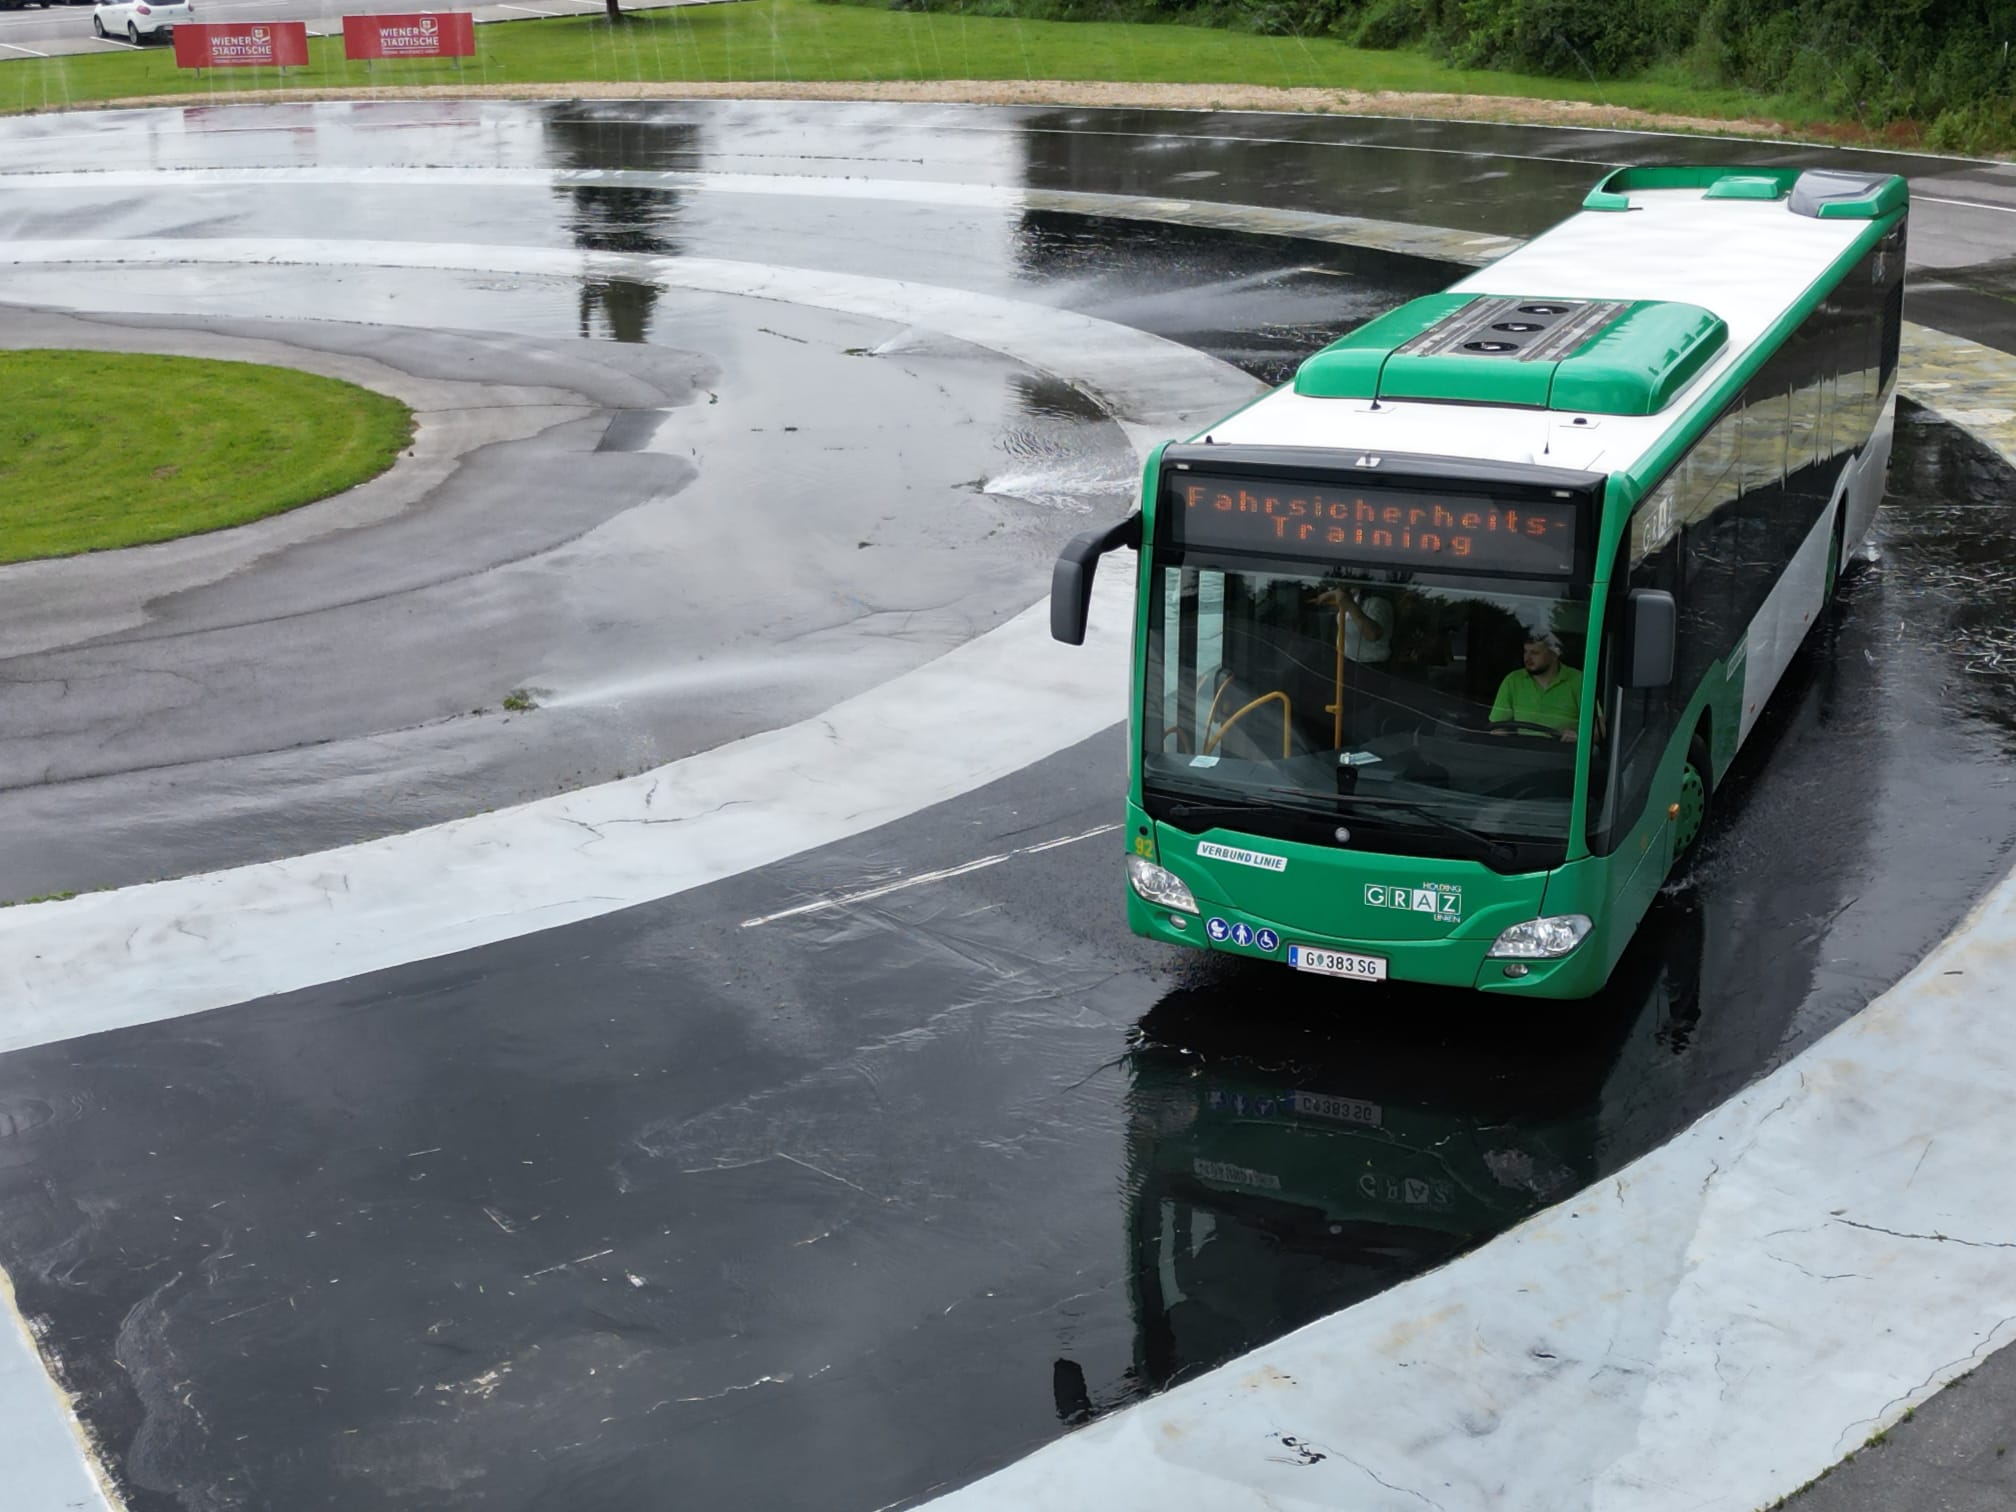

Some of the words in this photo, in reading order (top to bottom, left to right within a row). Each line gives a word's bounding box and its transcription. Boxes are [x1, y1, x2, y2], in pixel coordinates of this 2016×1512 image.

[211, 36, 252, 46] WIENER
[379, 27, 419, 37] WIENER
[1187, 485, 1567, 537] Fahrsicherheits-
[1272, 515, 1471, 556] Training
[1135, 837, 1153, 858] 92
[1202, 843, 1251, 863] VERBUND
[1253, 856, 1284, 869] LINIE
[1367, 886, 1457, 913] GRAZ
[1306, 952, 1315, 966] G
[1326, 955, 1354, 971] 383
[1358, 960, 1376, 975] SG
